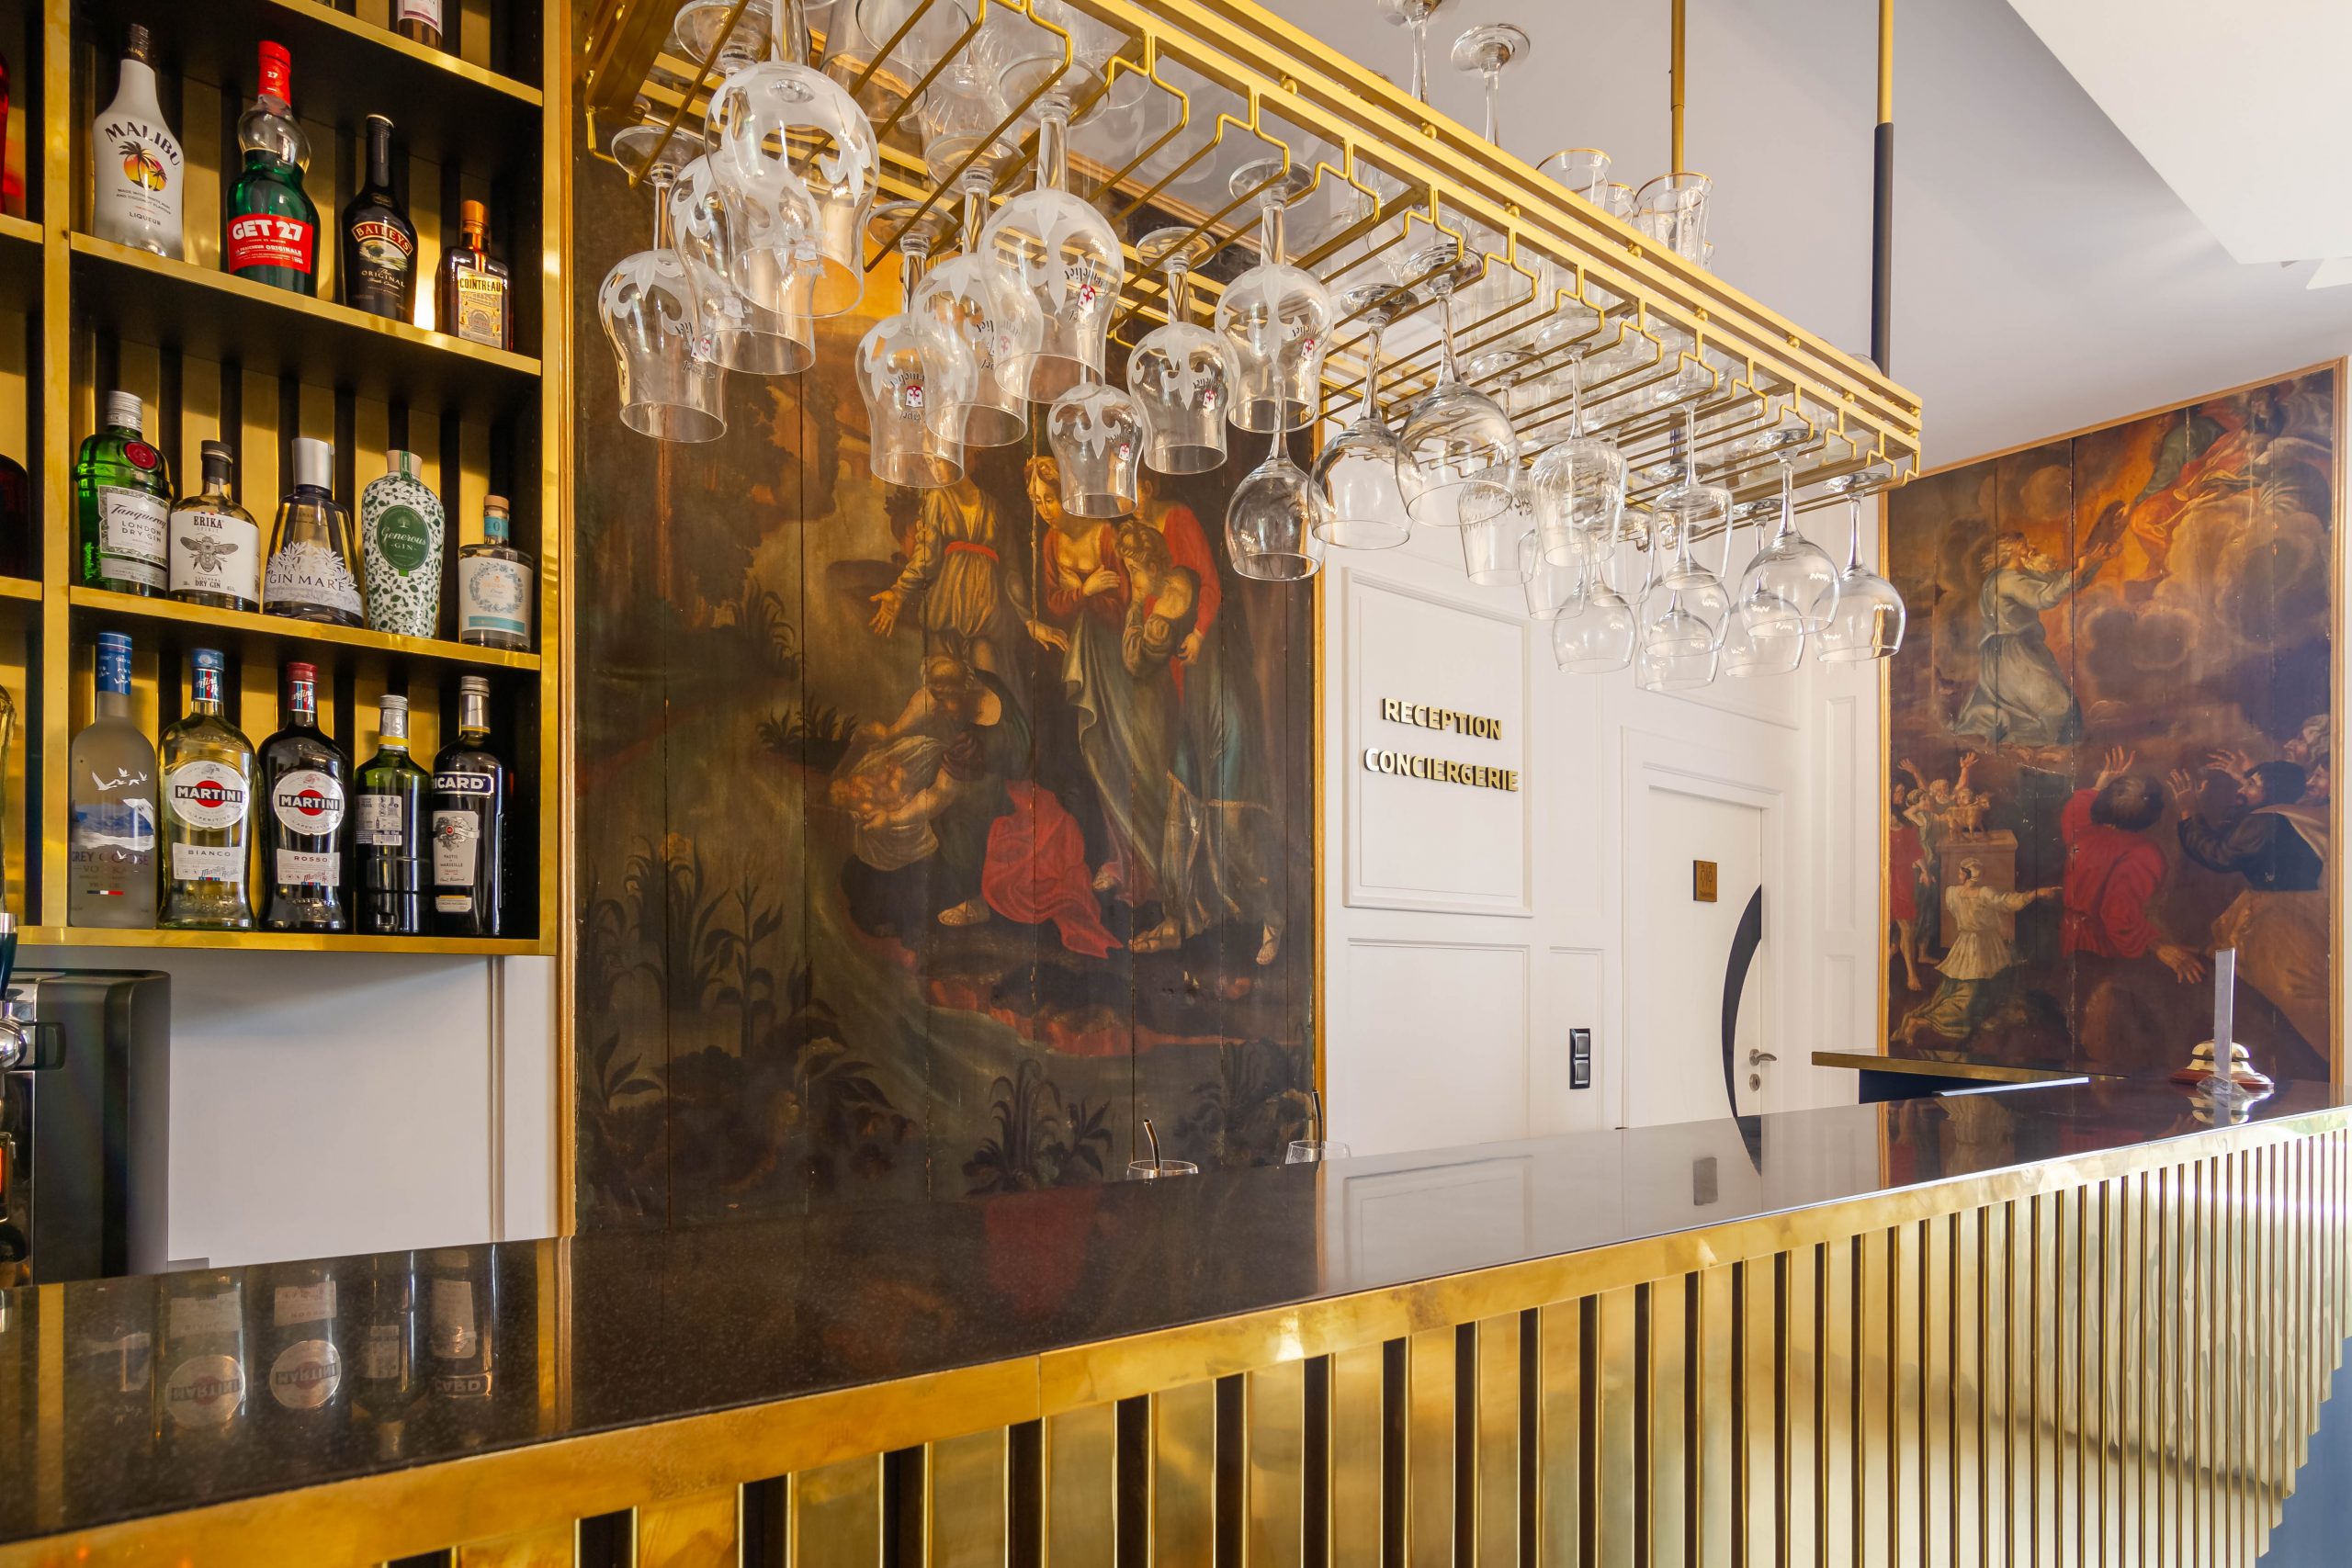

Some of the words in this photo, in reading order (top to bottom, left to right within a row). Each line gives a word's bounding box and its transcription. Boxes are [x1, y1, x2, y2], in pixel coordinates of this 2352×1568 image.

[105, 121, 180, 166] MALIBU
[129, 211, 162, 226] LIQUEUR
[232, 219, 273, 240] GET
[276, 220, 303, 242] 27
[356, 225, 410, 251] BAILEYS
[361, 270, 405, 288] ORIGINAL
[459, 277, 502, 292] COINTREAU
[110, 502, 167, 529] Tanqueray
[193, 515, 223, 530] ERIKA
[121, 520, 162, 536] LONDON
[121, 527, 142, 536] DRY
[146, 533, 162, 543] GIN
[380, 526, 427, 546] Generous
[394, 542, 413, 551] GIN
[269, 573, 293, 584] GIN
[298, 574, 346, 592] MARE
[1382, 697, 1502, 741] RECEPTION
[1363, 747, 1519, 793] CONCIERGERIE
[435, 776, 485, 791] ICARD
[176, 786, 242, 802] MARTINI
[281, 795, 339, 810] MARTINI
[187, 849, 232, 857] BIANCO
